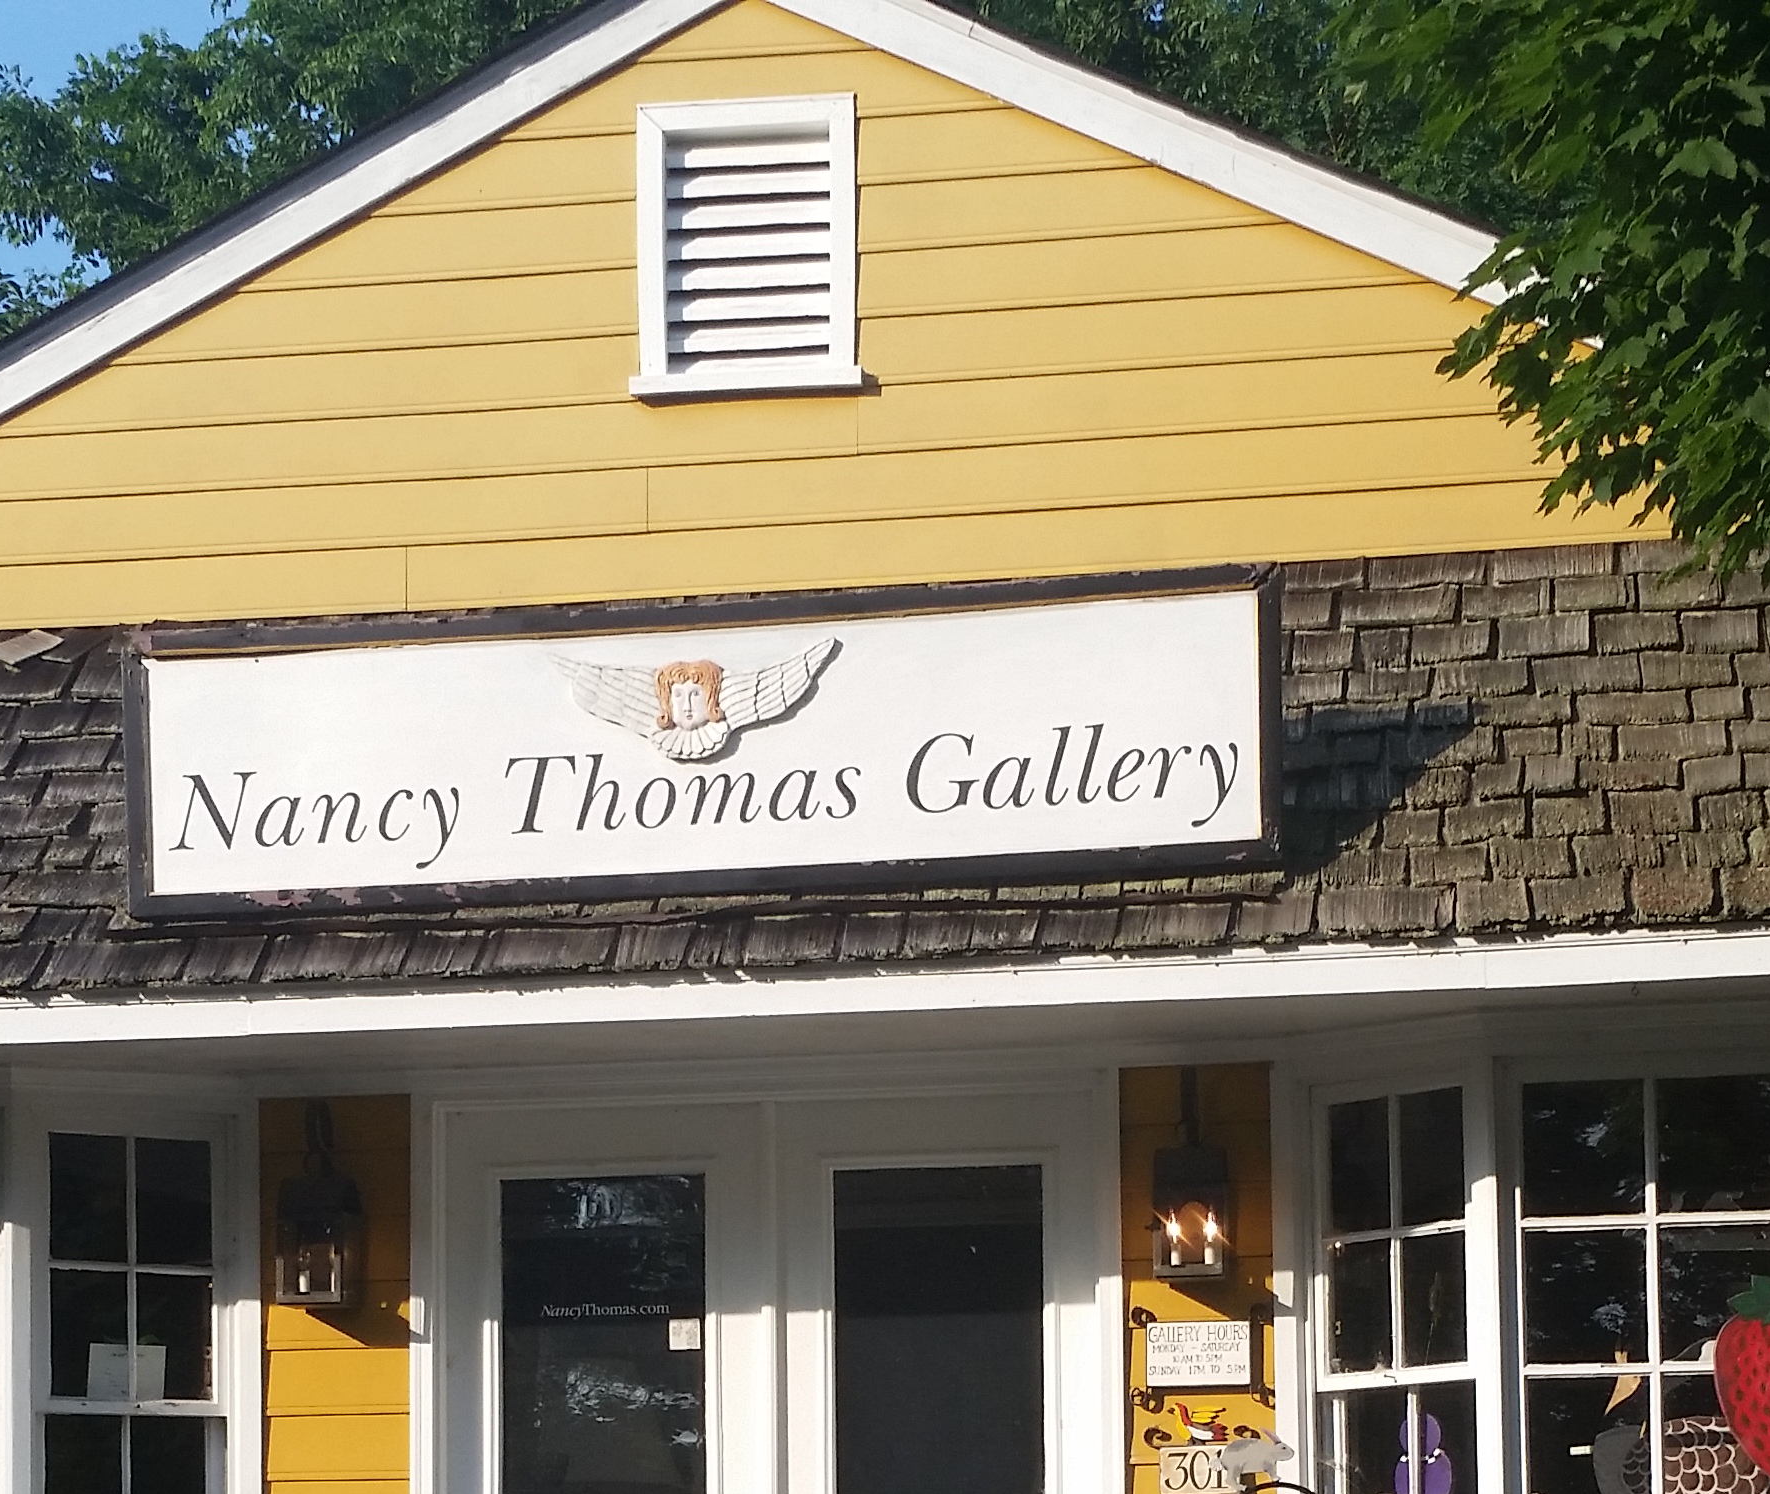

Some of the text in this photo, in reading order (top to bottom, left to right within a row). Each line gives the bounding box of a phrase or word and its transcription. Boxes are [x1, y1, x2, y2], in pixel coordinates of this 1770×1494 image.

[169, 723, 1240, 868] Nancy Thomas Gallery
[539, 1303, 670, 1320] NancyThomas.com
[1148, 1324, 1249, 1343] GALLERY HOURS
[1148, 1365, 1182, 1376] SUNDAY
[1210, 1365, 1221, 1374] TO
[1164, 1449, 1228, 1490] 301
